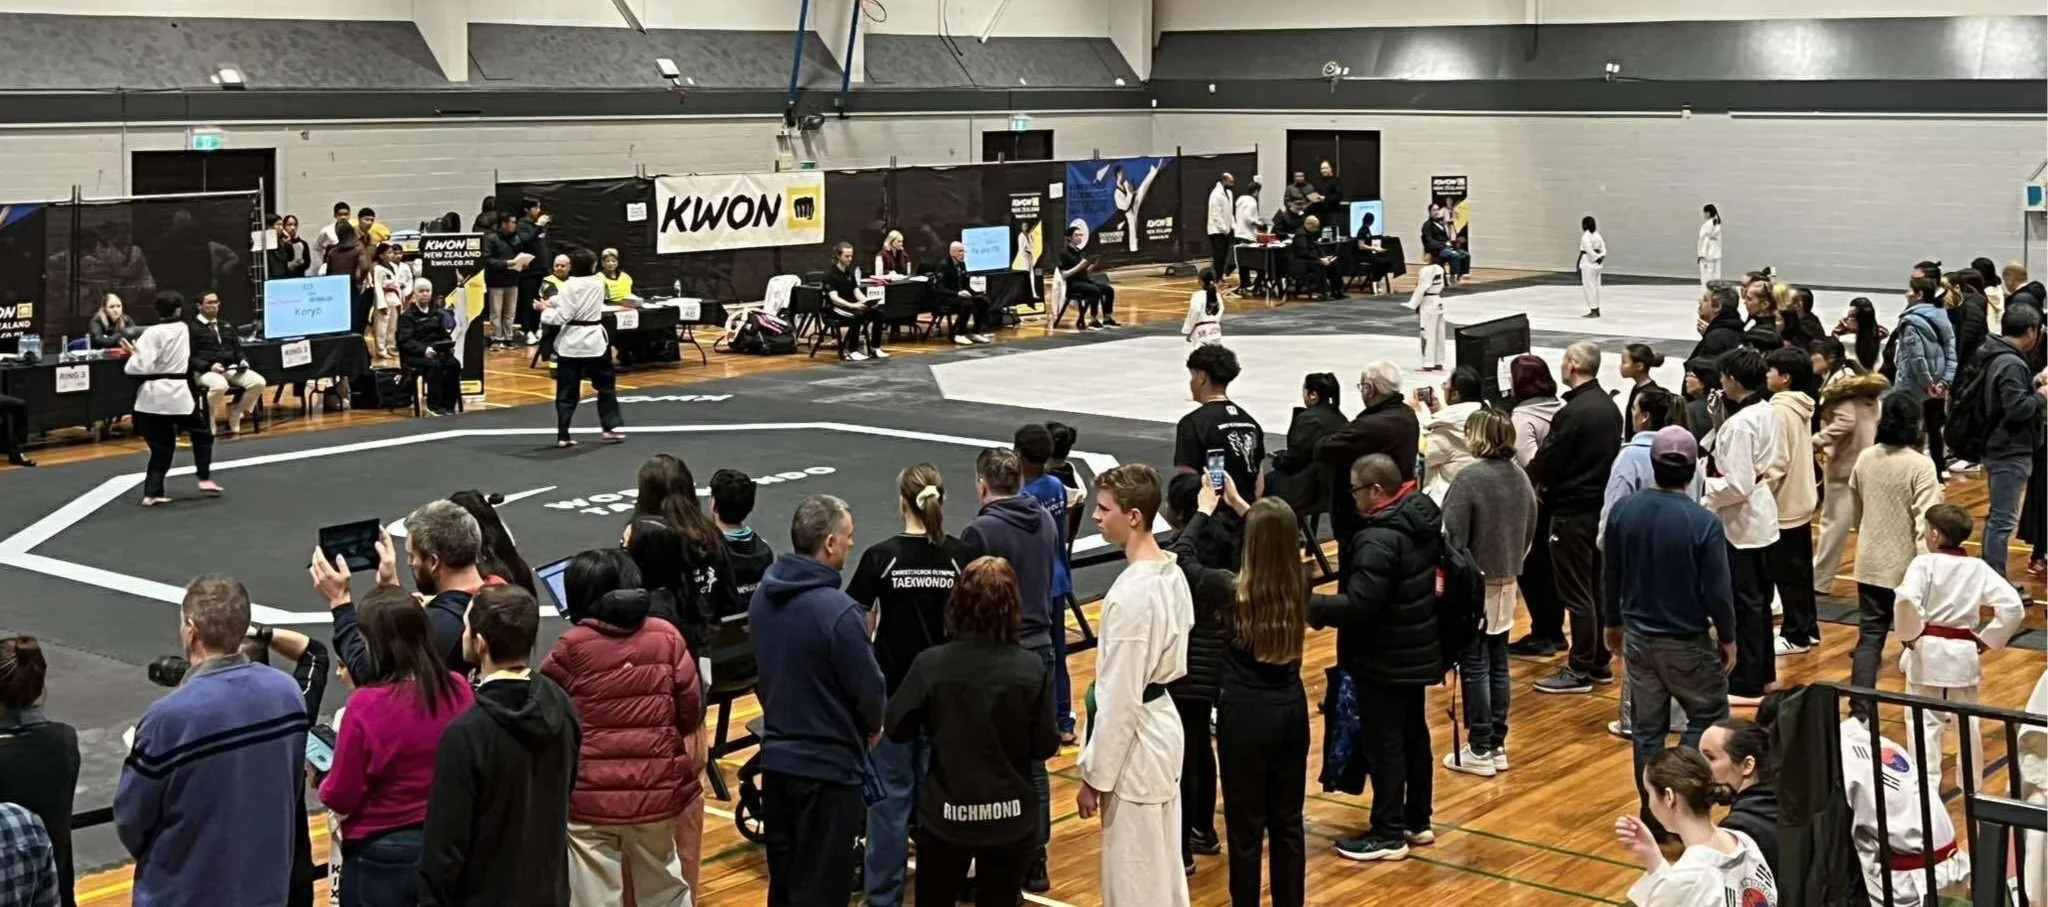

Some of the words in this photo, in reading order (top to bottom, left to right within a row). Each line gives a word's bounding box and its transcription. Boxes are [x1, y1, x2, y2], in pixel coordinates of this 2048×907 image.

[660, 193, 782, 233] KWON
[425, 240, 466, 250] KWON
[444, 250, 482, 258] ZEALAND
[891, 577, 955, 588] TAEKWONDO
[943, 799, 1021, 821] RICHMOND
